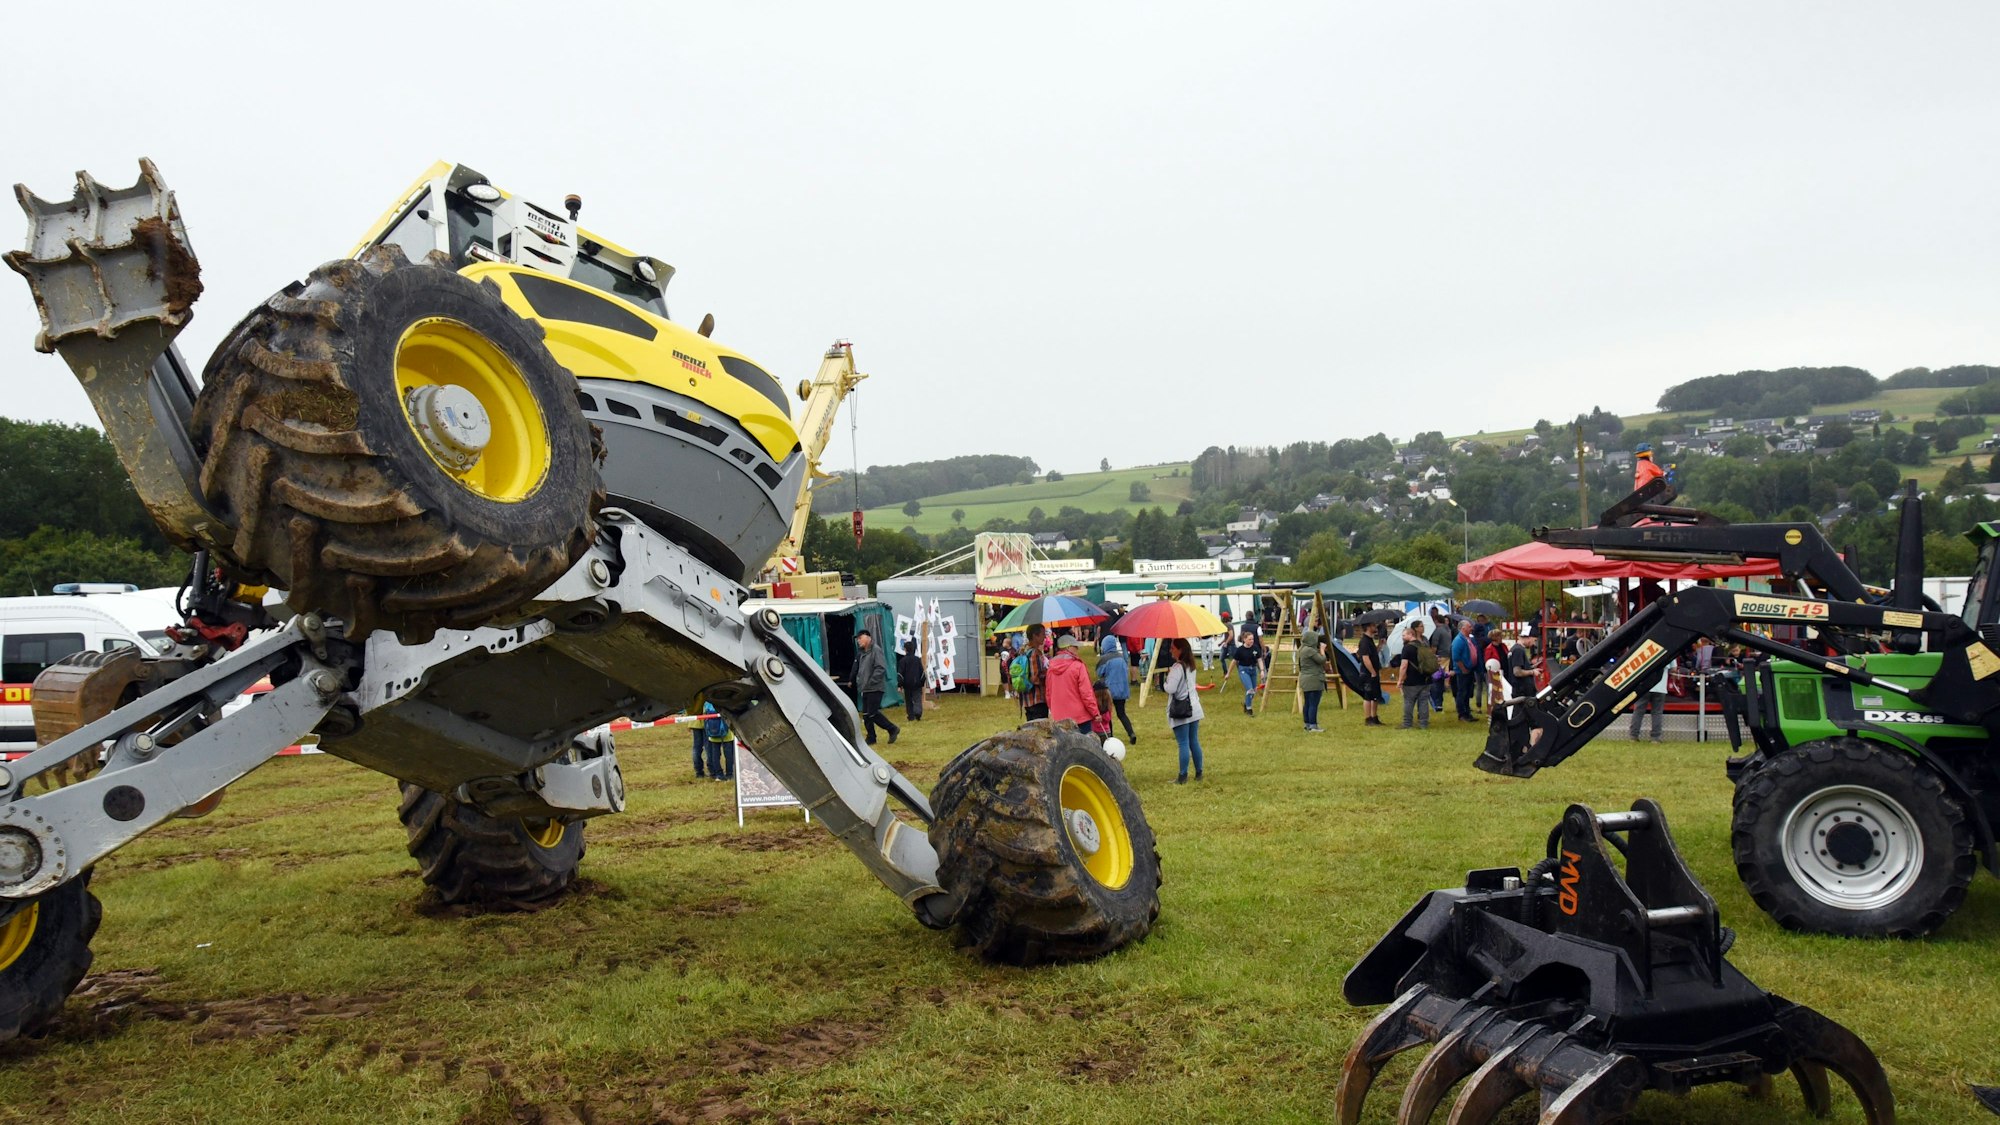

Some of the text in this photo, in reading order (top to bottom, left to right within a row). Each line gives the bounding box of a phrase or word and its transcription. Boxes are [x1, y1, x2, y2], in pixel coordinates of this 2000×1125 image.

[527, 211, 560, 231] menzi
[672, 349, 706, 369] menzi
[682, 361, 712, 379] muck
[1741, 603, 1824, 618] ROBUST F 15
[1610, 644, 1659, 687] STOLL
[1864, 710, 1944, 724] DX3.65
[1559, 849, 1581, 915] MVD
